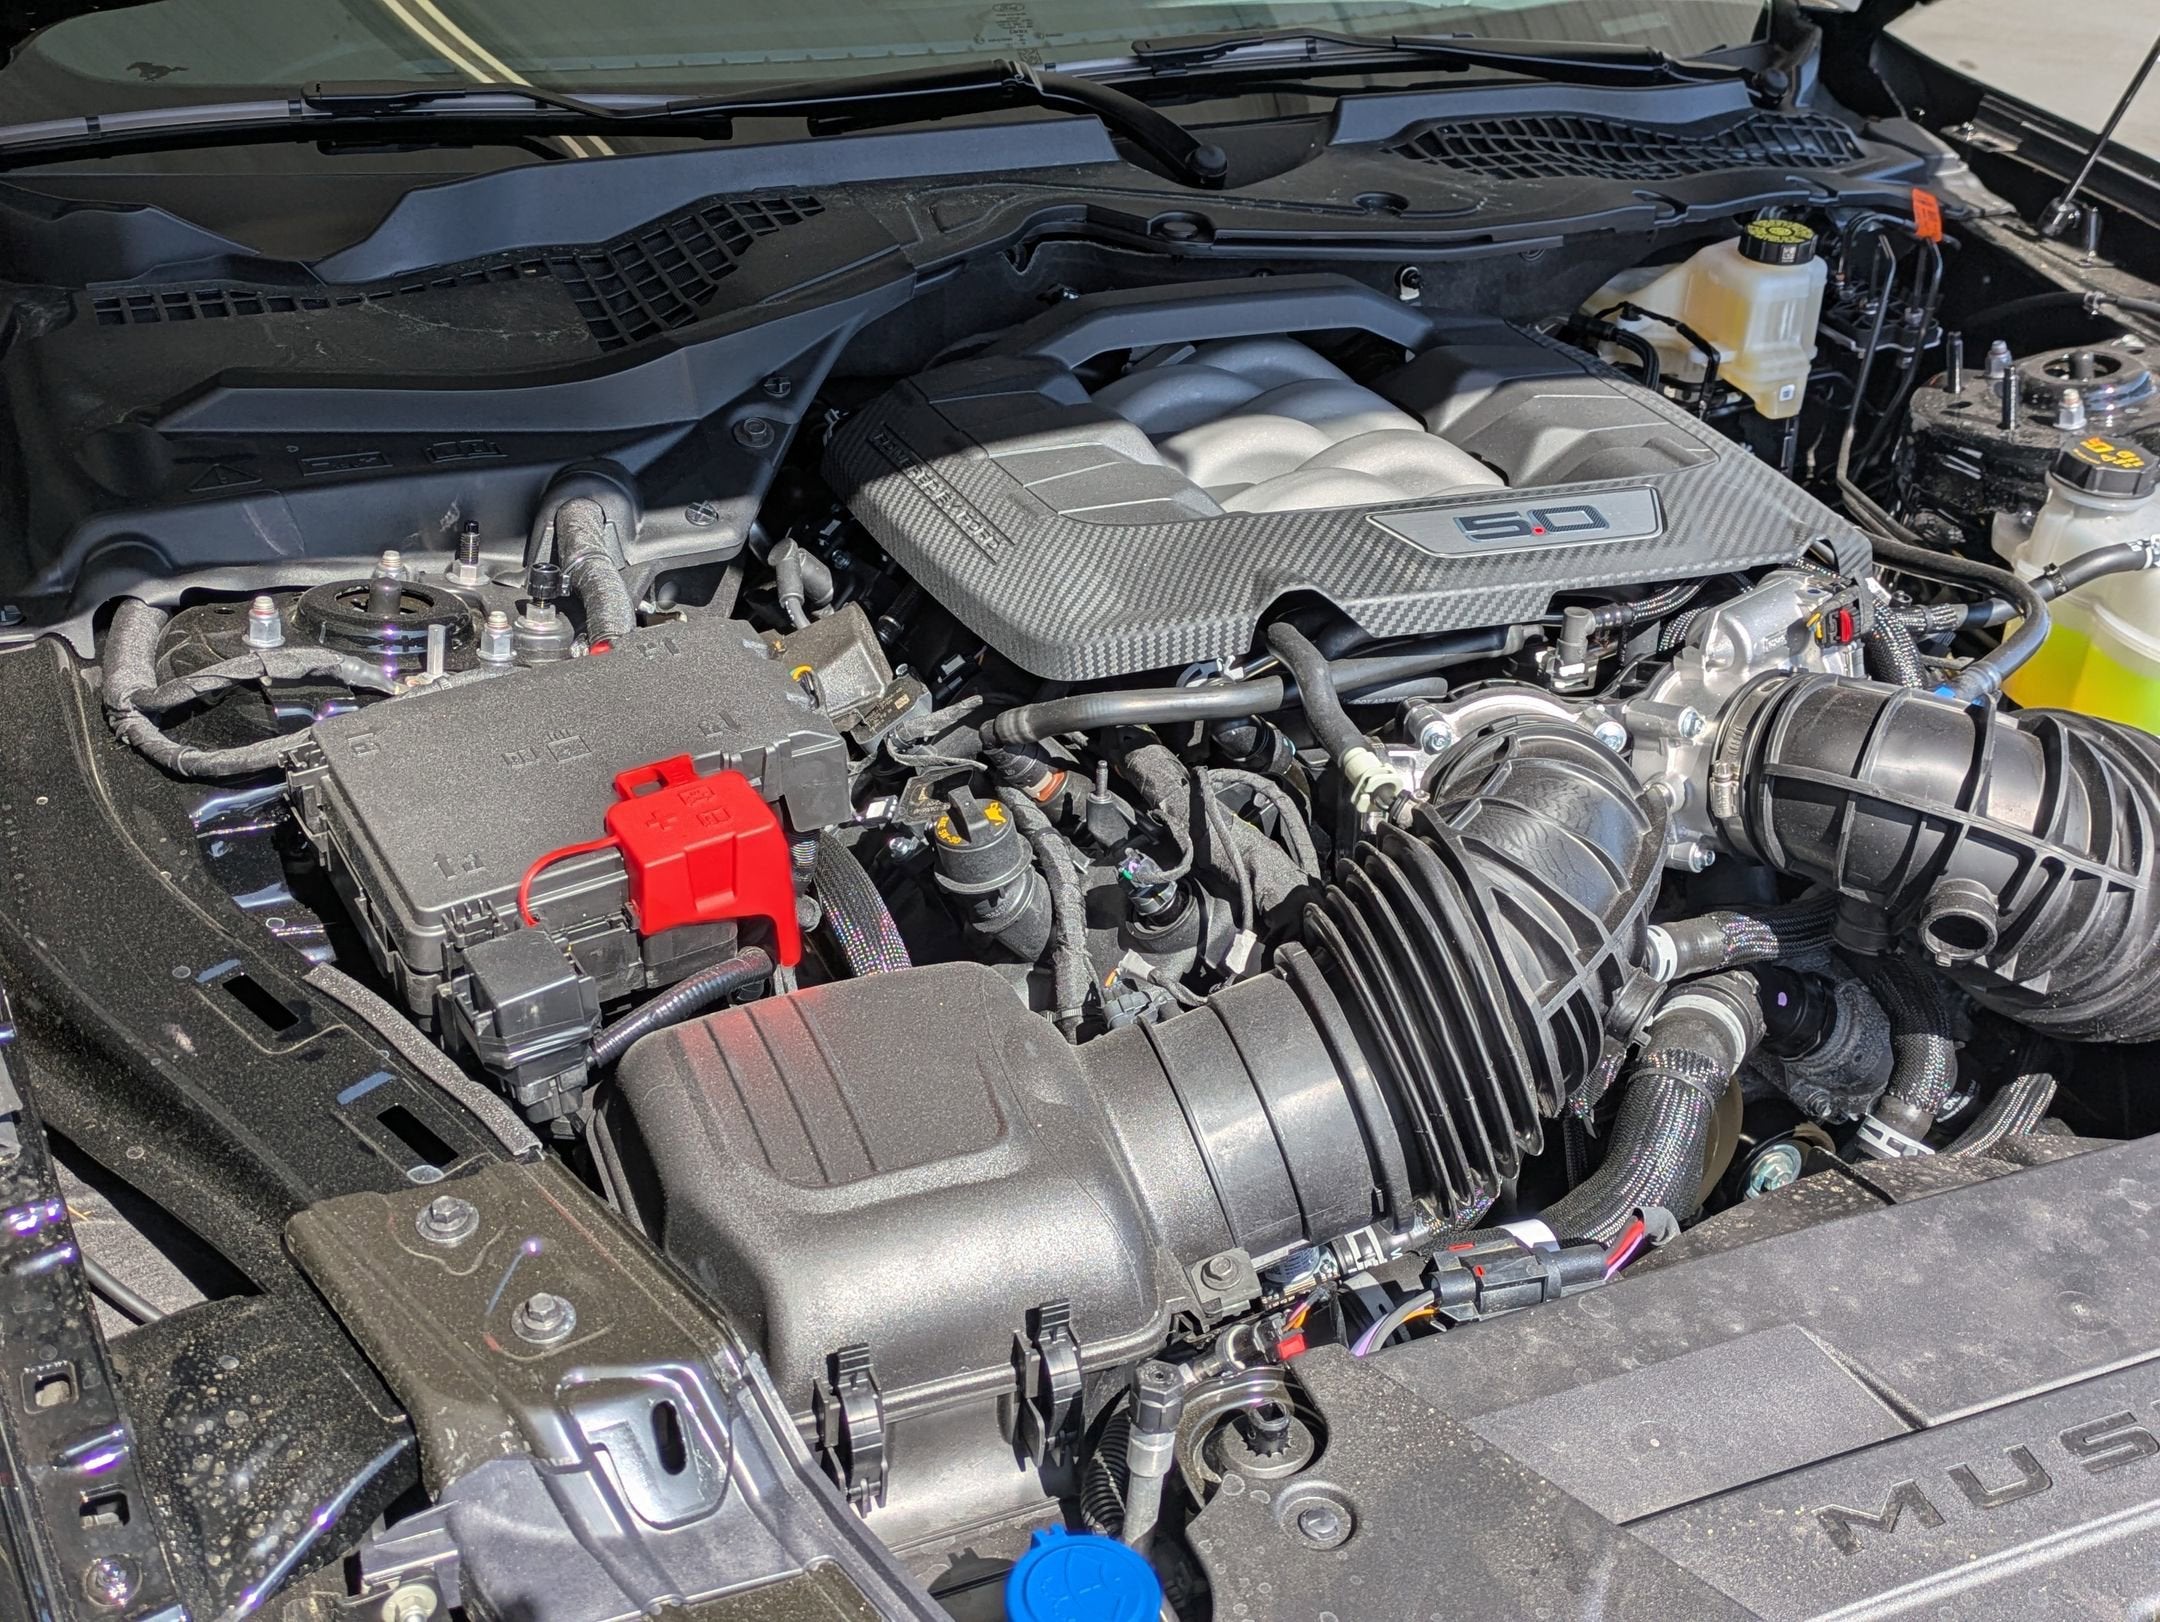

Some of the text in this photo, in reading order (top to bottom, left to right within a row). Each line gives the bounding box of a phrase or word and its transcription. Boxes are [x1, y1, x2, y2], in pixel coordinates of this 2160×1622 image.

[873, 432, 1001, 549] POWERED BY FORD
[1453, 505, 1609, 541] 5.0
[1811, 1401, 2160, 1557] MUS
